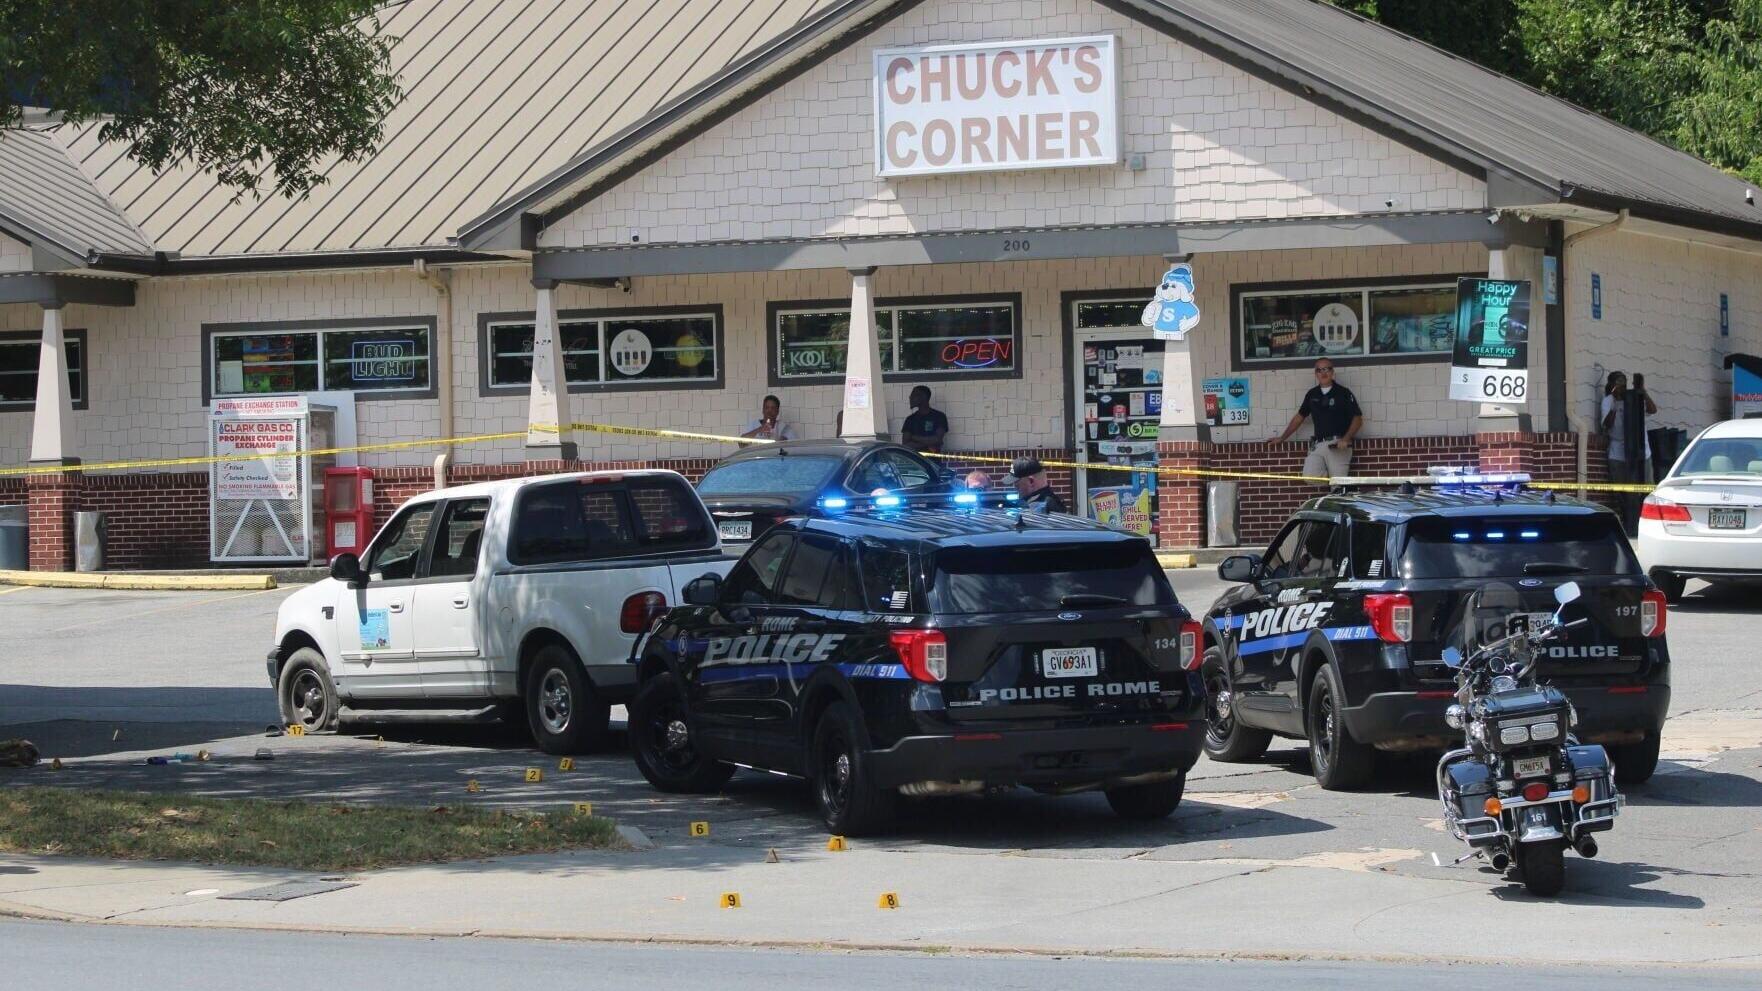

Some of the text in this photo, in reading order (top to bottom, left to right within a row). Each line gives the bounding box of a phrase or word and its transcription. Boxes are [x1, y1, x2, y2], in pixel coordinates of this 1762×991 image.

[886, 45, 1103, 105] CHUCK'S
[886, 110, 1103, 169] CORNER
[1003, 239, 1030, 251] 200
[1478, 281, 1517, 296] Happy
[1481, 295, 1513, 306] Hour
[1162, 308, 1175, 322] S
[363, 344, 404, 359] BUD
[941, 341, 1012, 362] OPEN
[1495, 347, 1517, 355] PRICE
[790, 350, 831, 367] KOOL
[355, 360, 410, 377] LIGHT
[218, 400, 298, 410] PROPANE EXCHANGE STATION
[224, 423, 295, 433] CLARK GAS CO.
[256, 434, 294, 442] CYLINDER
[1121, 505, 1142, 513] CHILL
[1121, 514, 1148, 522] SERVED
[1277, 587, 1305, 603] ROME
[1615, 606, 1638, 616] 197
[761, 616, 800, 632] ROME
[1239, 601, 1335, 641] POLICE
[1334, 627, 1368, 639] DIAL 911
[703, 633, 847, 664] POLICE
[1154, 637, 1176, 649] 134
[1050, 655, 1092, 670] GV693A1
[851, 664, 897, 677] DIAL 911
[979, 681, 1161, 701] POLICE ROME
[292, 726, 302, 735] 17
[529, 770, 536, 780] 2
[579, 804, 587, 815] 5
[1530, 812, 1547, 823] 161
[696, 824, 704, 835] 6
[727, 894, 736, 906] 9
[886, 894, 895, 906] 8
